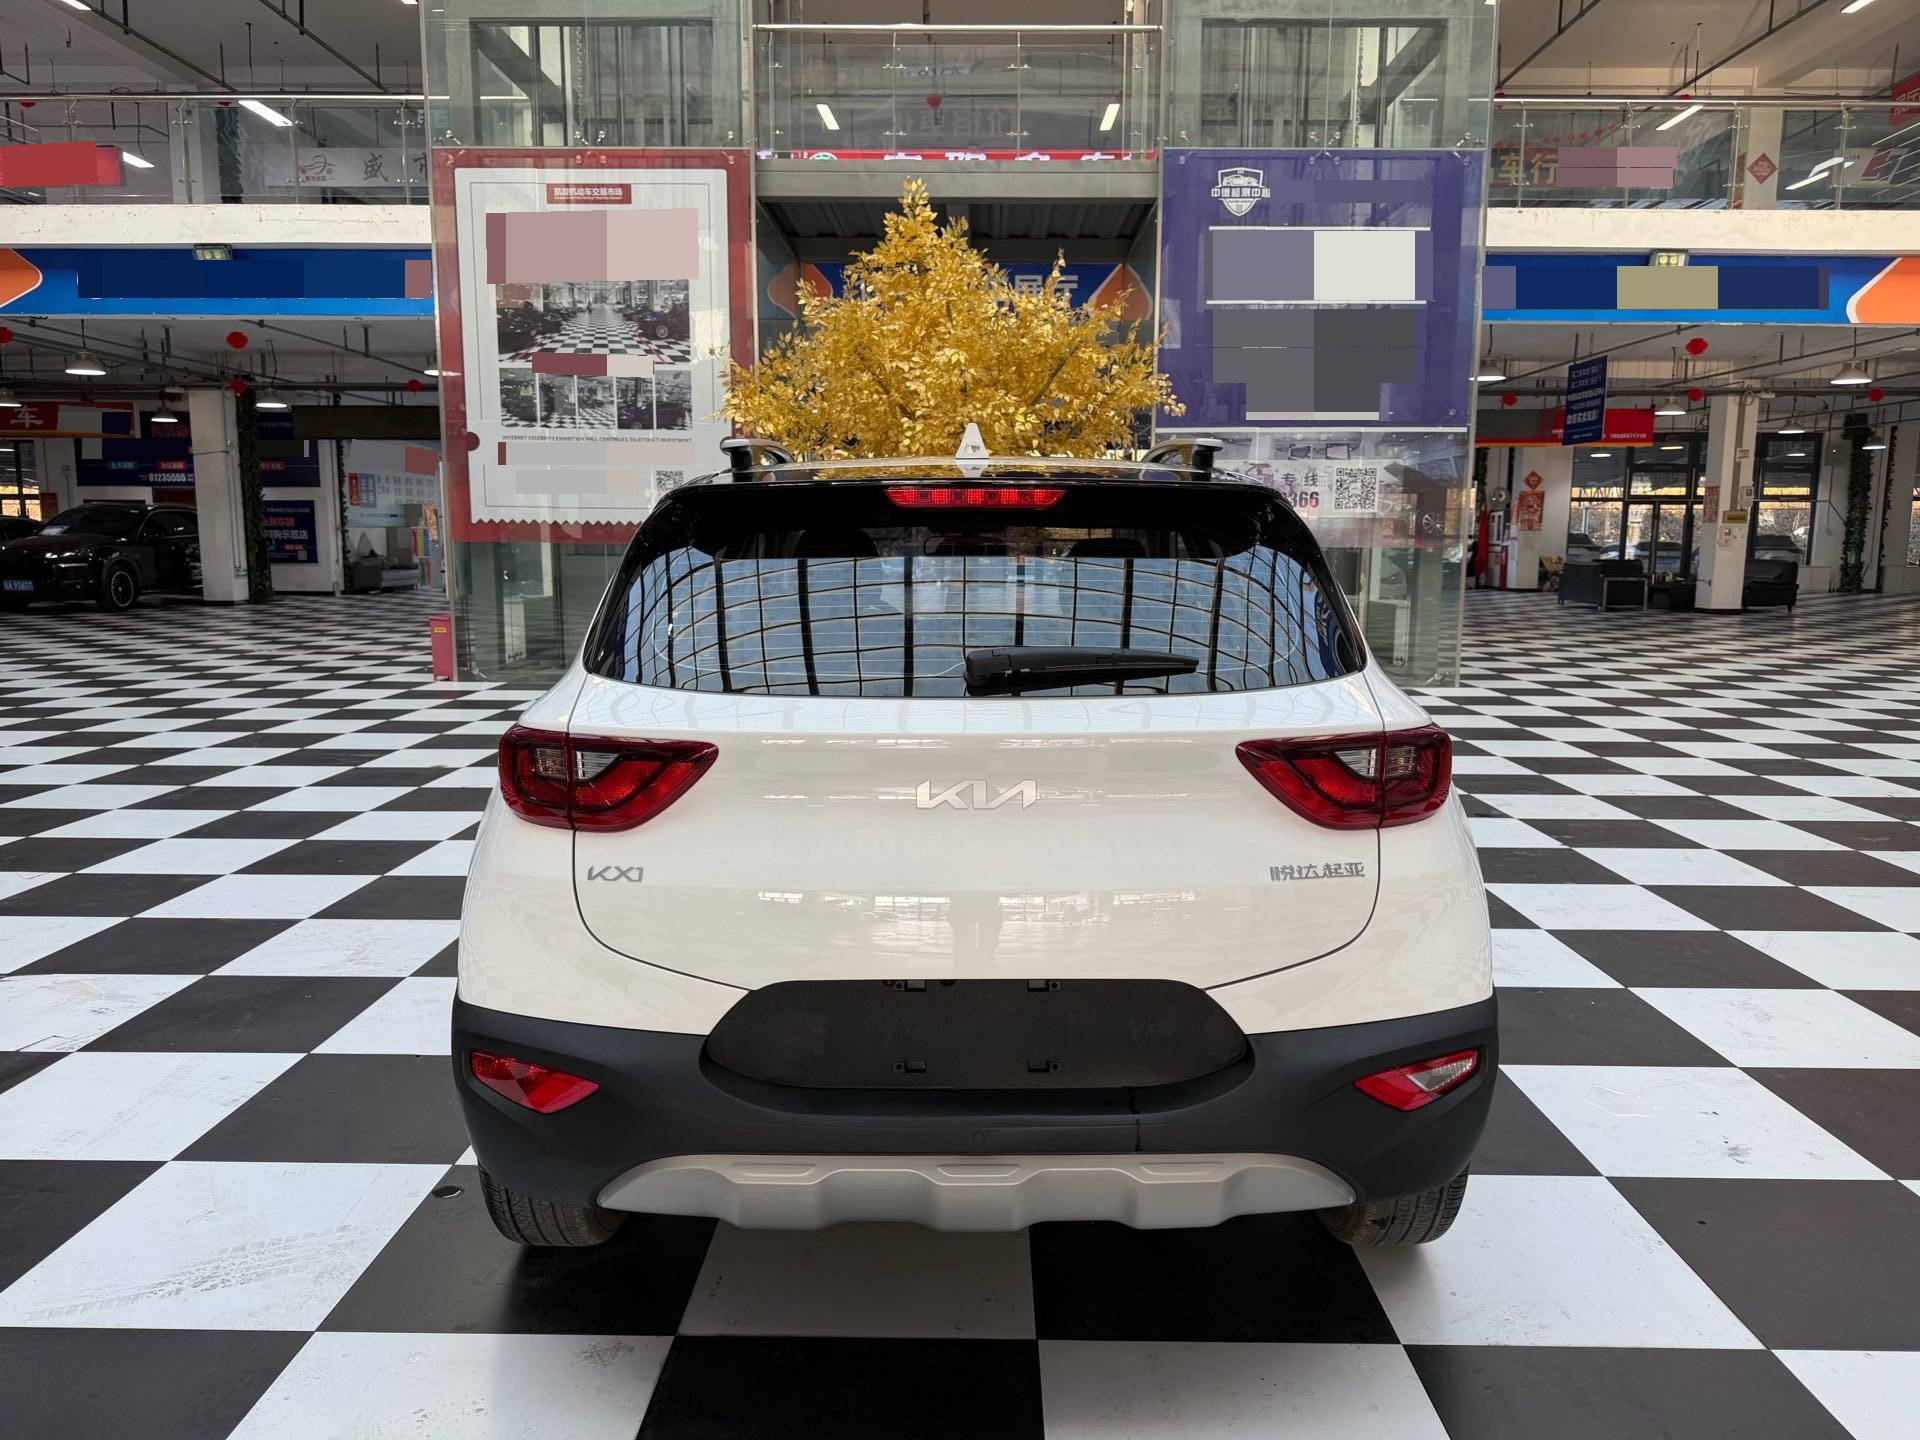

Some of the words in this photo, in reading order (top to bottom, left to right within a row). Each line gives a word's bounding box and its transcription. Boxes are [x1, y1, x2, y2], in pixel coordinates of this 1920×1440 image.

[916, 779, 1037, 810] KIA
[1269, 862, 1365, 881] 悦达起亚
